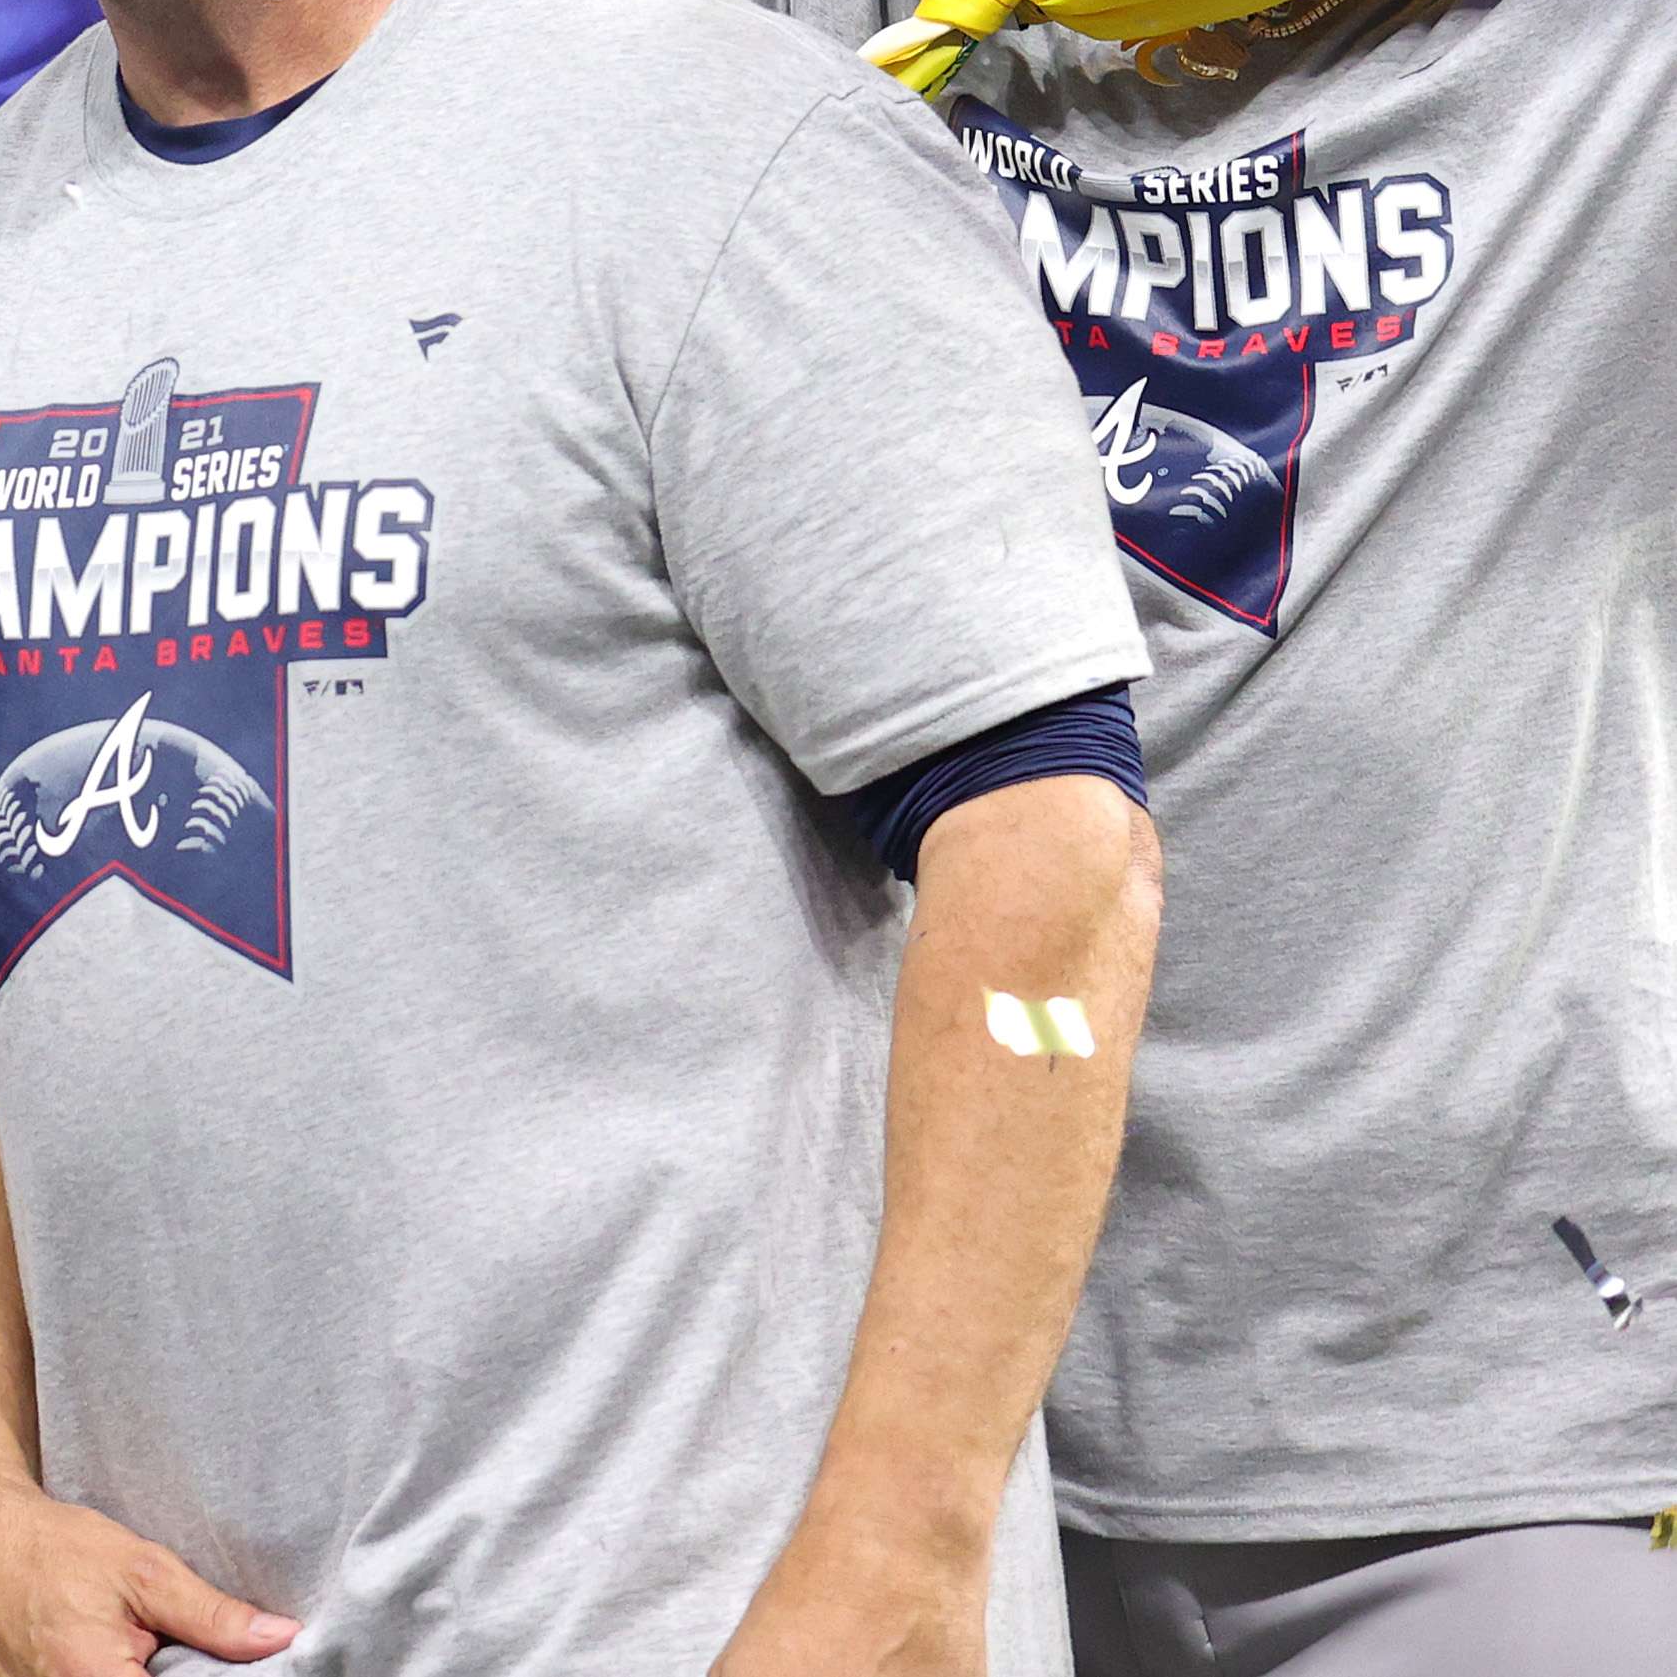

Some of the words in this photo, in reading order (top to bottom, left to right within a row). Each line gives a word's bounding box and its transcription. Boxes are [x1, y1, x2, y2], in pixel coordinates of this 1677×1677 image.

[962, 127, 1074, 192] WORLD
[1143, 156, 1283, 205] SERIES
[1151, 313, 1404, 360] BRAVES
[49, 427, 109, 460] 20
[179, 415, 225, 452] 21
[170, 443, 284, 502] SERIES
[154, 618, 372, 669] BRAVES
[35, 690, 161, 859] A
